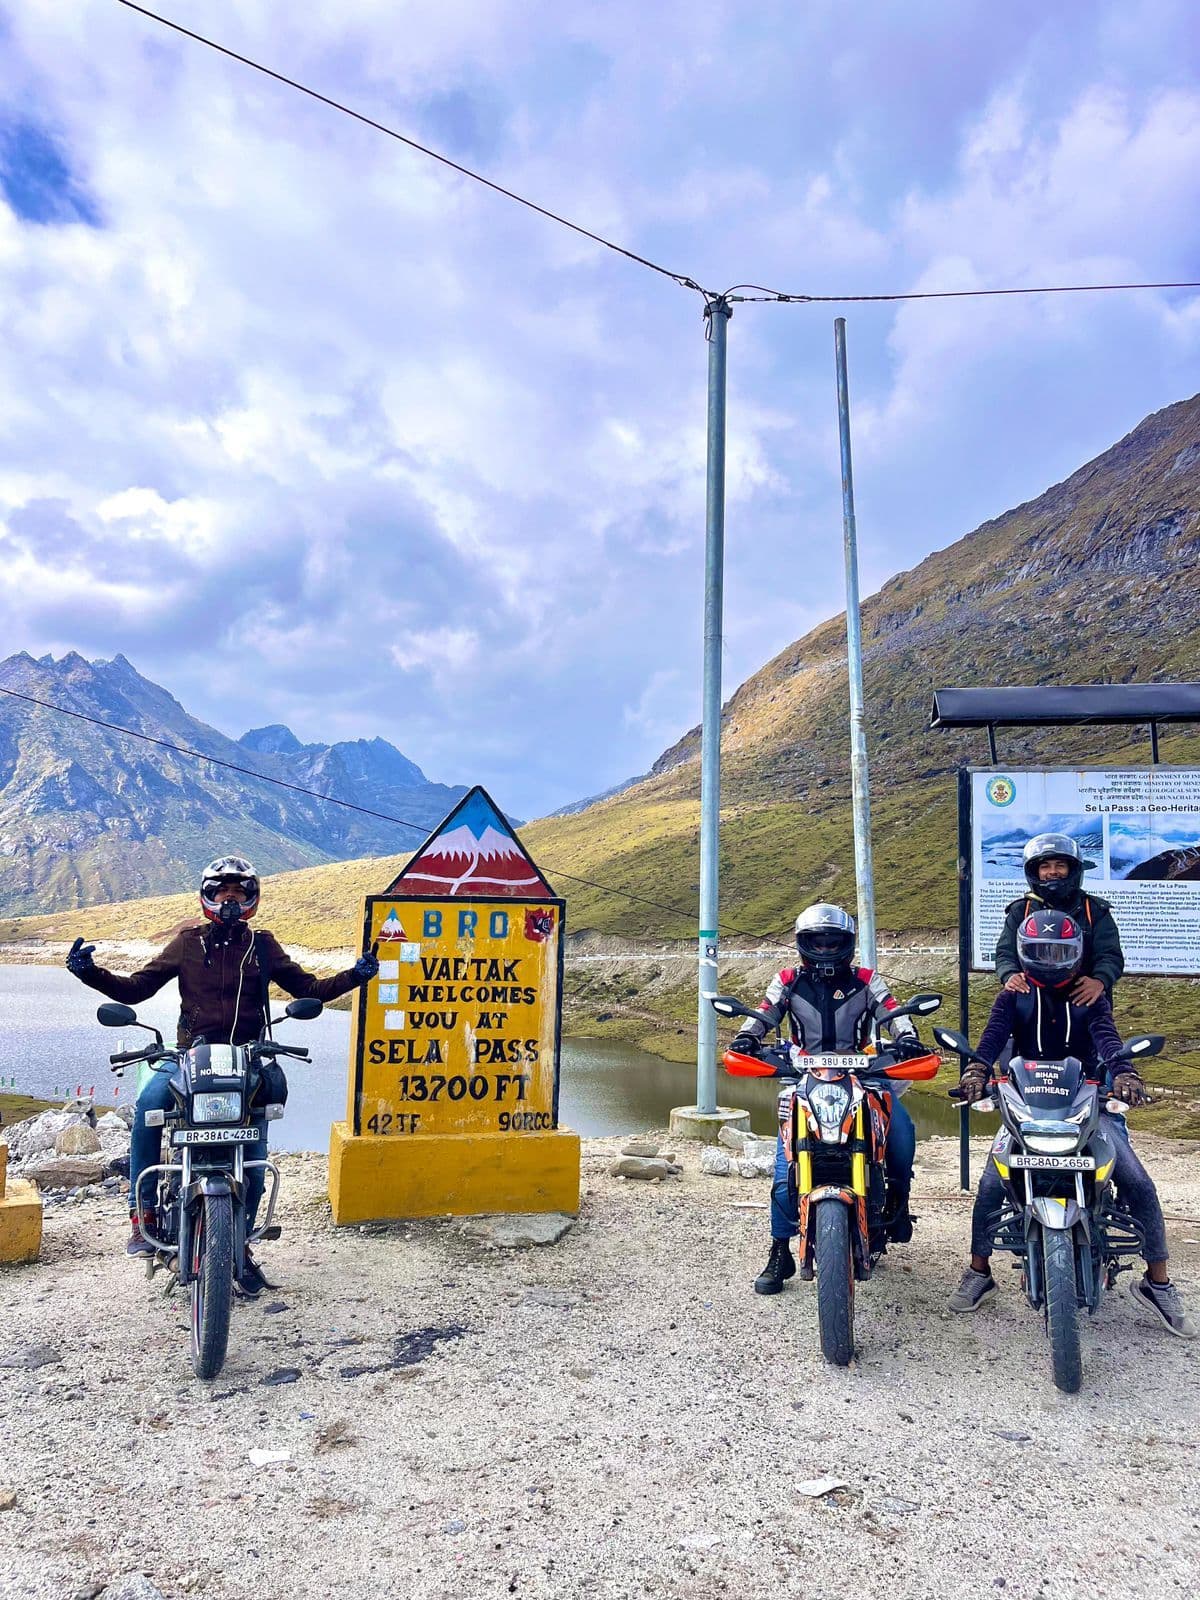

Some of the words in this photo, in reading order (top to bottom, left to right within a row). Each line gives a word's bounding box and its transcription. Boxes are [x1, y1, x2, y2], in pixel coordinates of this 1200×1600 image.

[1085, 804, 1096, 812] Se
[1099, 804, 1110, 812] La
[1112, 804, 1134, 812] Pass
[1141, 804, 1146, 812] a
[1148, 804, 1200, 812] Geo-Herita
[420, 957, 522, 981] VARTAK
[407, 985, 538, 1004] WELCOMES
[408, 1011, 459, 1029] YOU
[475, 1012, 508, 1029] AT
[368, 1039, 444, 1064] SELA
[474, 1039, 539, 1063] PASS
[399, 1075, 489, 1101] 13700
[494, 1075, 530, 1101] FT
[1024, 1087, 1070, 1096] NORTHEAST
[367, 1114, 393, 1135] 42
[396, 1114, 421, 1134] TF
